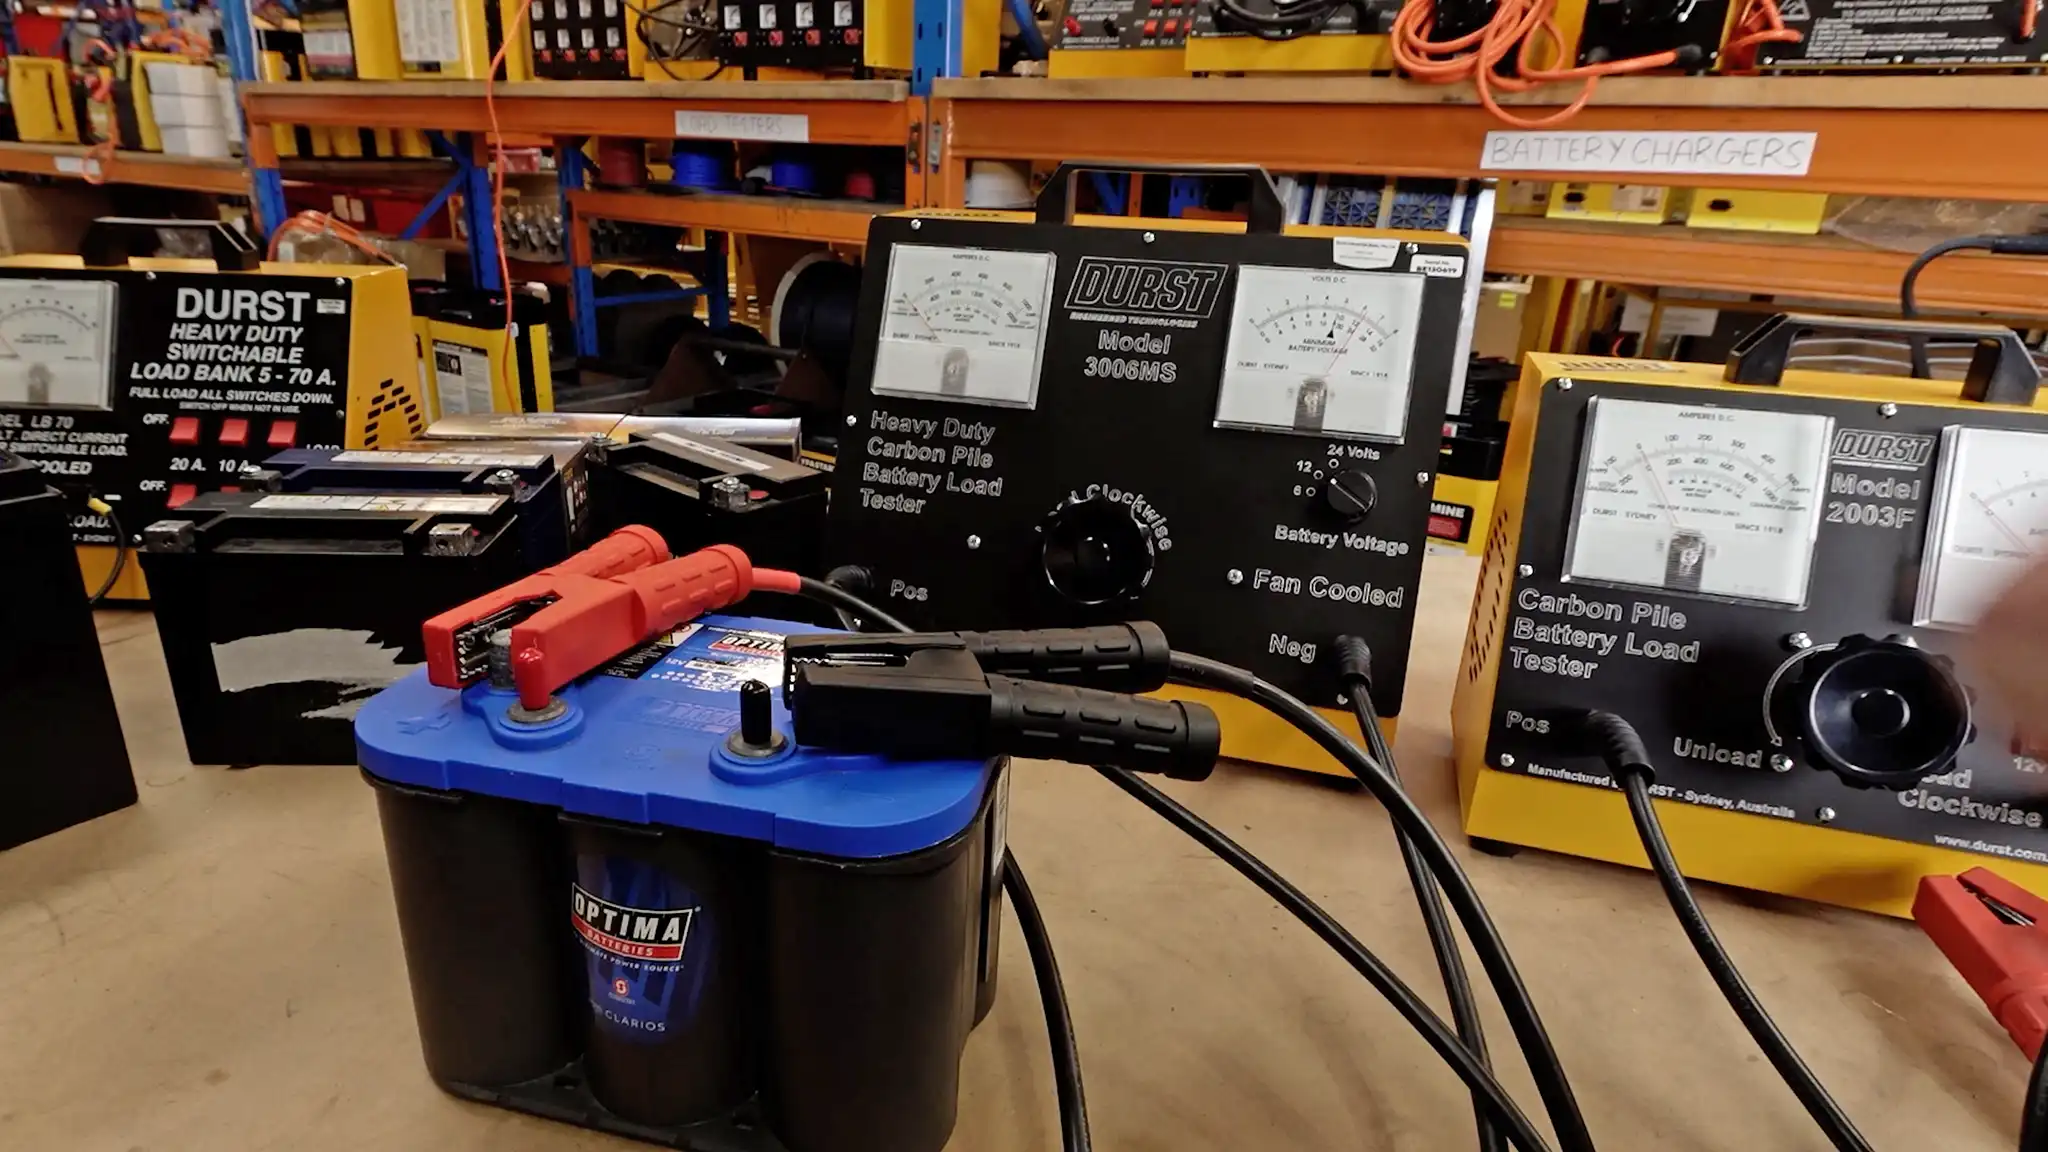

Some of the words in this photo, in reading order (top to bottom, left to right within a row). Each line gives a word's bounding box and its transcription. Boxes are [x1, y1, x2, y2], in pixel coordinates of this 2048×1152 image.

[724, 115, 783, 135] TESTERS
[1491, 136, 1626, 164] BATTERY
[1632, 137, 1805, 169] CHARGERS
[1074, 263, 1218, 312] DURST
[176, 287, 311, 322] DURST
[170, 323, 242, 341] HEAVY
[245, 325, 304, 343] DUTY
[1128, 316, 1199, 328] TECHNOLOGIES
[166, 343, 304, 364] SWITCHABLE
[1098, 329, 1171, 355] Model
[1288, 344, 1315, 353] BATTERY
[1317, 347, 1348, 355] VOLTAGE
[1303, 337, 1336, 346] MINIMUM
[130, 362, 190, 380] LOAD
[193, 364, 255, 383] BANK
[258, 367, 272, 383] 5
[289, 368, 313, 385] 70
[316, 369, 336, 386] A.
[1084, 355, 1177, 383] 3006MS
[129, 387, 160, 398] FULL
[163, 388, 198, 400] LOAD
[199, 389, 223, 400] ALL
[225, 389, 291, 403] SWITCHES
[292, 392, 334, 404] DOWN.
[179, 401, 210, 410] SWITCH
[211, 402, 228, 411] OFF
[229, 403, 252, 412] WHEN
[254, 404, 272, 412] NOT
[30, 415, 53, 428] LB
[55, 416, 74, 429] 70
[143, 413, 169, 425] OFF.
[870, 410, 937, 440] Heavy
[943, 417, 996, 445] Duty
[1678, 411, 1715, 421] AMPERES
[9, 442, 89, 455] SWITCHABLE
[21, 430, 67, 442] DIRECT
[68, 432, 129, 444] CURRENT
[867, 437, 946, 465] Carbon
[951, 445, 994, 469] Pile
[1327, 443, 1344, 457] 24
[1347, 446, 1381, 461] Volts
[1836, 432, 1930, 467] DURST
[32, 460, 93, 475] OOLED
[169, 458, 190, 471] 20
[190, 458, 207, 471] A.
[219, 460, 236, 472] 10
[1296, 460, 1312, 473] 12
[139, 480, 167, 491] OFF.
[863, 462, 941, 494] Battery
[946, 472, 1003, 497] Load
[1293, 485, 1302, 496] 6
[1831, 472, 1921, 501] Model
[860, 487, 926, 514] Tester
[69, 515, 111, 528] OAD.
[1086, 484, 1172, 551] Clockwise
[1626, 511, 1658, 521] SYDNEY
[1826, 501, 1917, 529] 2003F
[1275, 524, 1338, 549] Battery
[1343, 532, 1409, 556] Voltage
[890, 579, 929, 602] Pos
[1253, 568, 1301, 595] Fan
[1309, 576, 1404, 608] Cooled
[1518, 588, 1623, 622] Carbon
[1631, 602, 1687, 630] Pile
[1268, 633, 1317, 663] Neg
[1513, 617, 1618, 656] Battery
[1624, 632, 1700, 663] Load
[1510, 646, 1598, 679] Tester
[1505, 710, 1550, 735] Pos
[1673, 736, 1763, 769] Unload
[1527, 763, 1610, 787] Manufactured
[1684, 790, 1735, 809] Sydney,
[1737, 799, 1796, 819] Australia
[1898, 788, 2043, 828] Clockwise
[574, 892, 680, 942] OPTIMA
[586, 929, 654, 957] BATTERIES
[610, 956, 640, 969] POWER
[605, 1009, 666, 1032] CLARIOS
